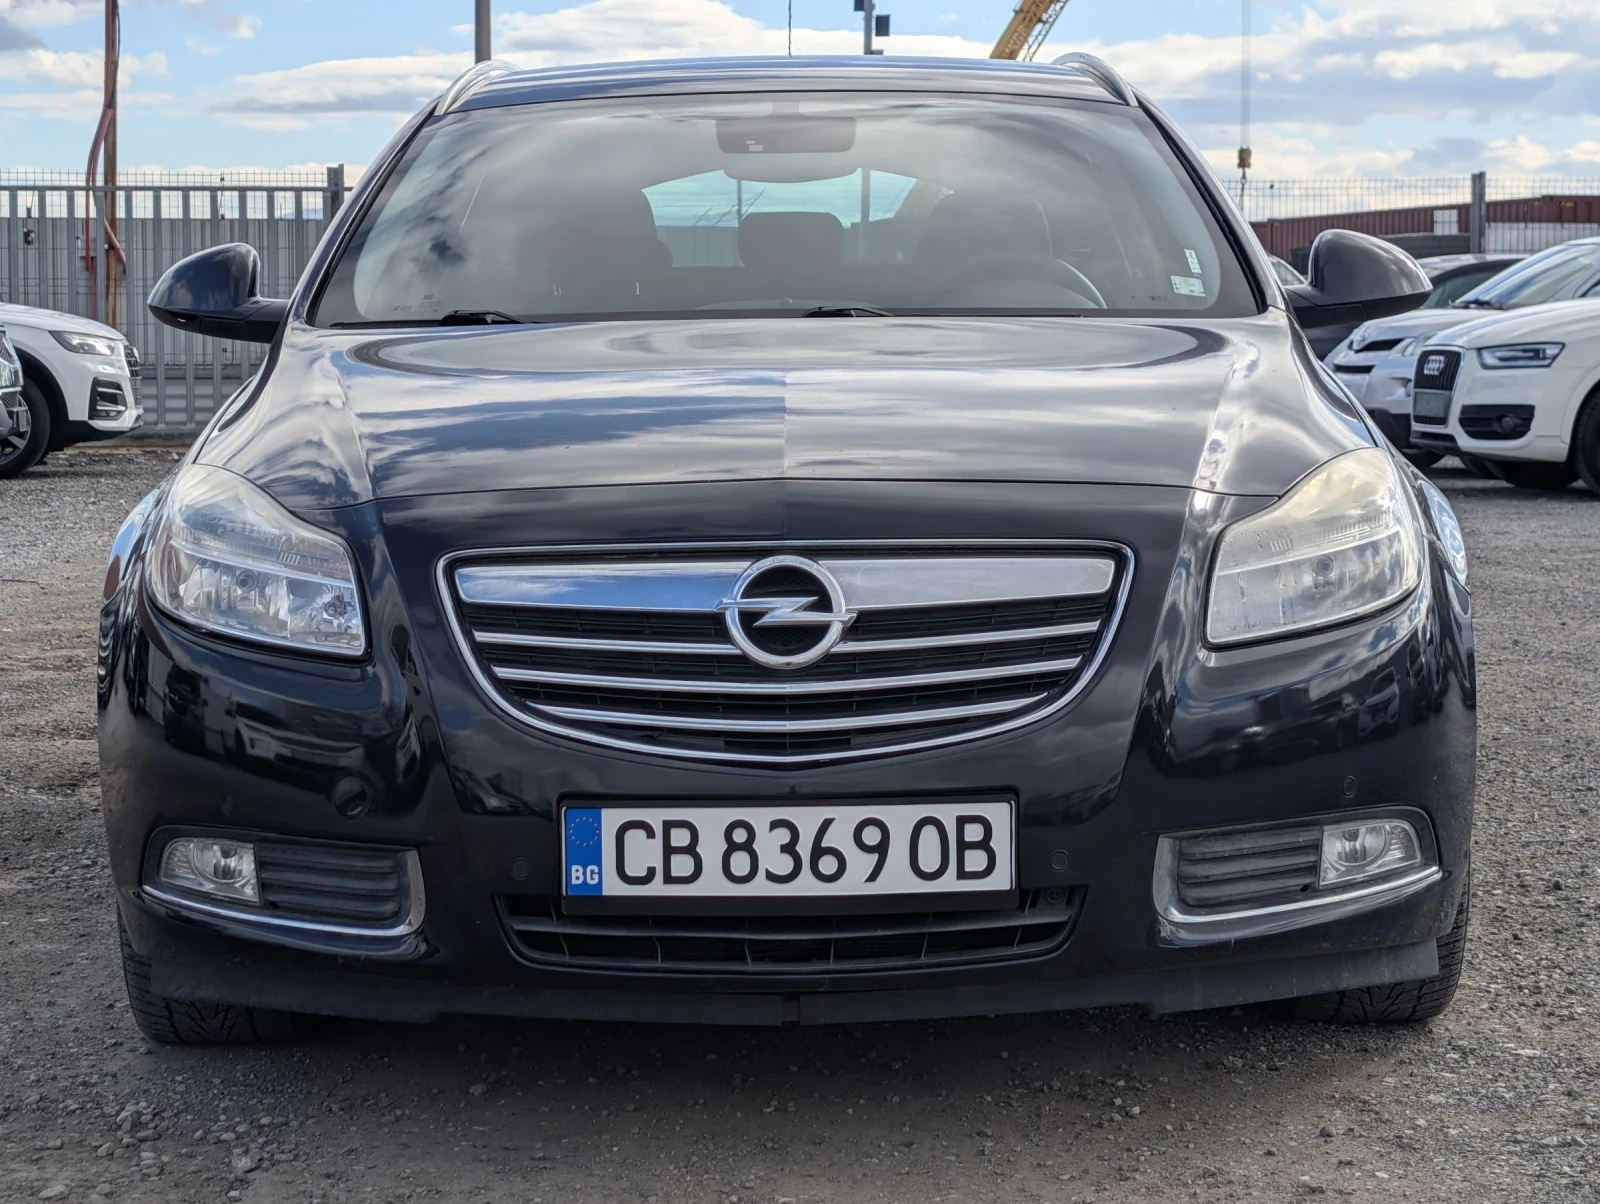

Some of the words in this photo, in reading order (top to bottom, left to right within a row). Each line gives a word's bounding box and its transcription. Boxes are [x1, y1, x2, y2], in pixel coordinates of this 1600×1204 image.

[615, 819, 703, 886] CB
[721, 816, 891, 884] 8369
[908, 814, 997, 881] OB
[571, 865, 599, 885] BG
